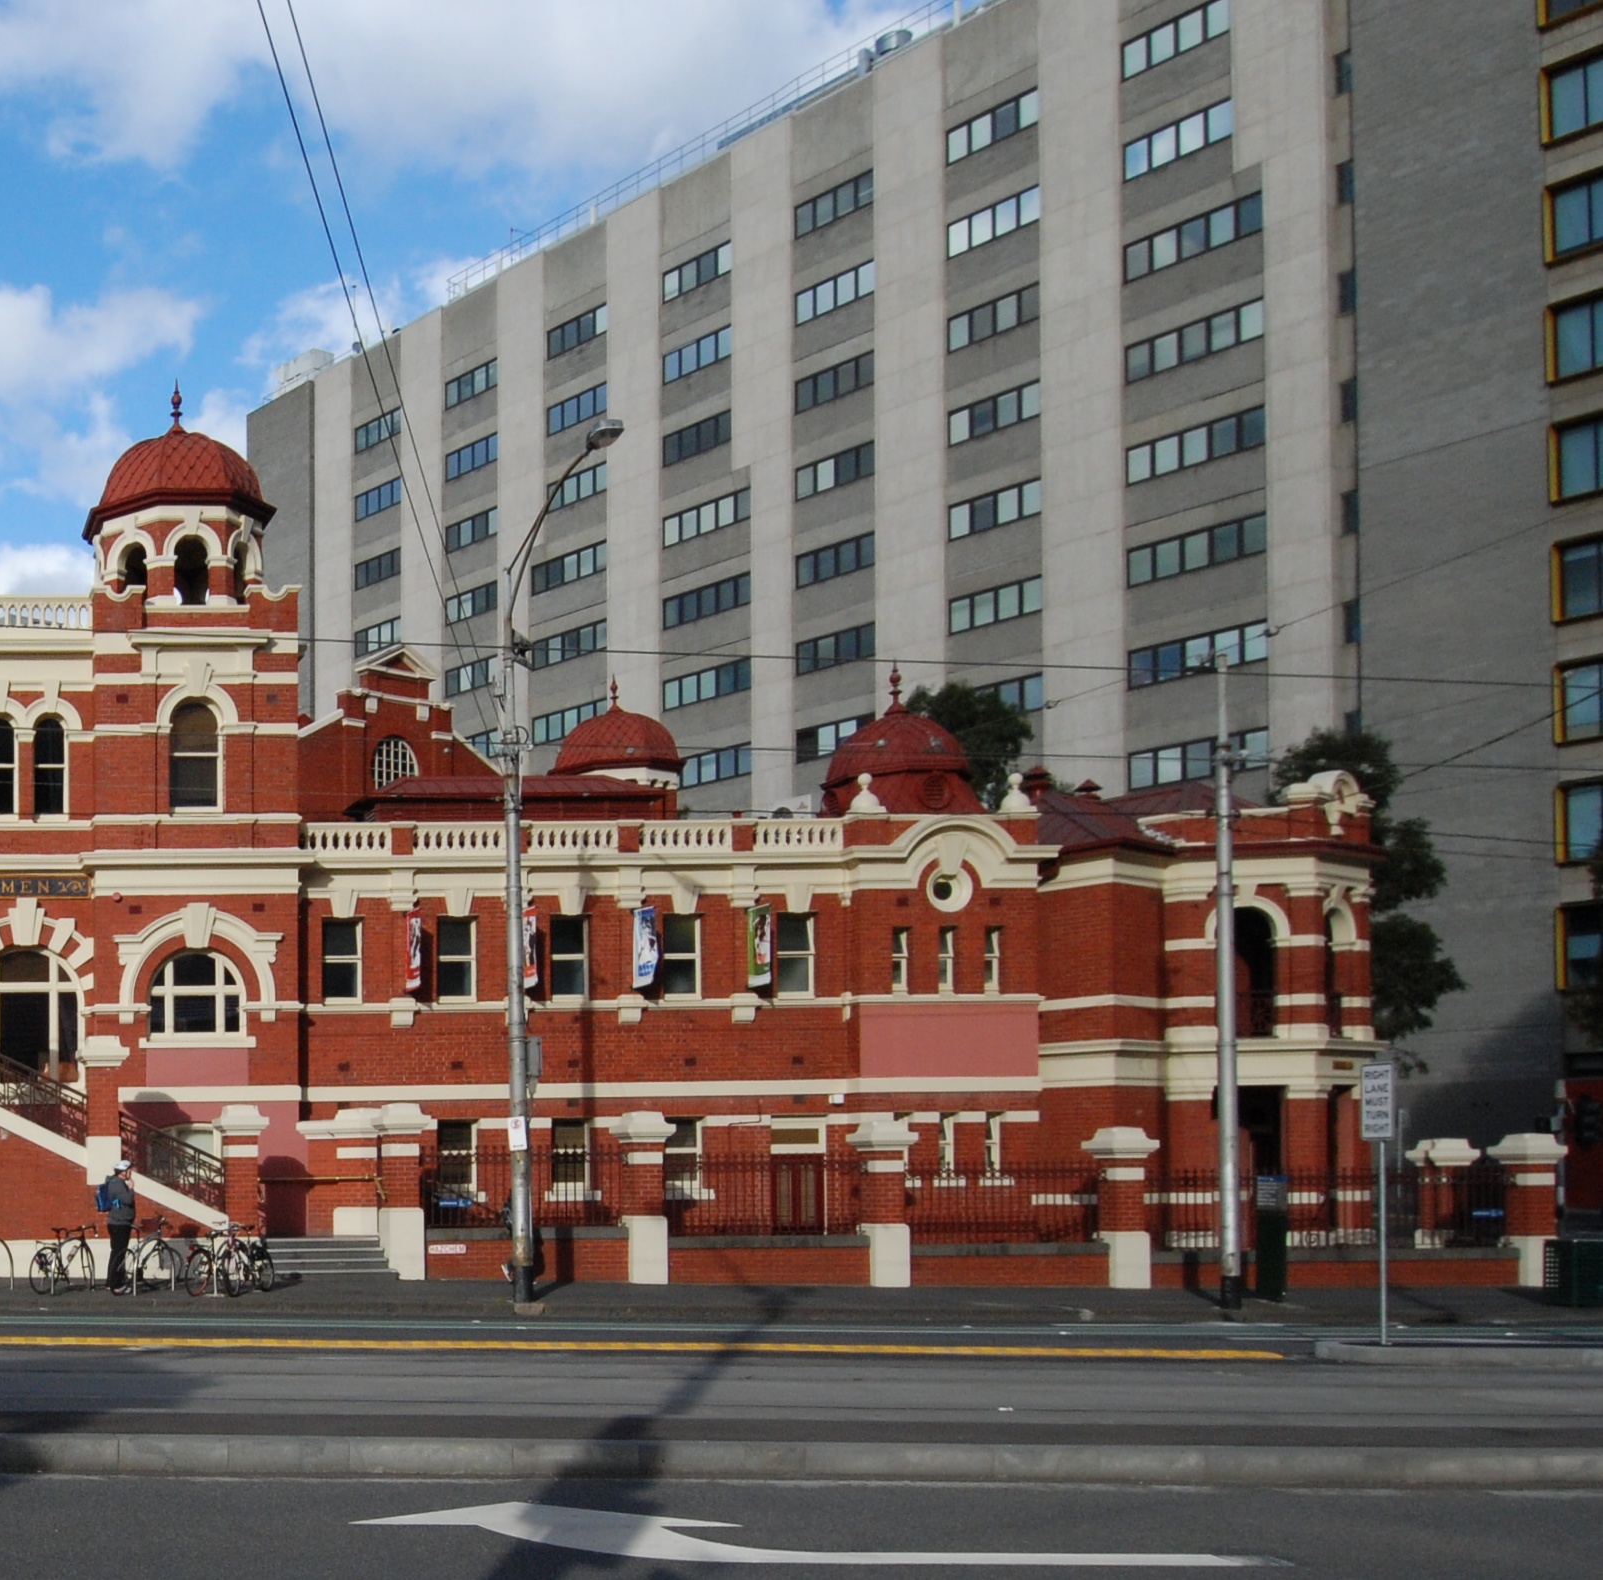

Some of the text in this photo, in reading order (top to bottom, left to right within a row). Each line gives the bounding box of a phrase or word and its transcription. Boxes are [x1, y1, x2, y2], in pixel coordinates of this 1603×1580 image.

[1, 880, 50, 893] MEN
[1364, 1069, 1389, 1079] RIGHT
[1364, 1083, 1389, 1094] LANE
[1365, 1096, 1389, 1106] MUST
[1366, 1110, 1389, 1120] TURN
[1364, 1123, 1389, 1133] RIGHT
